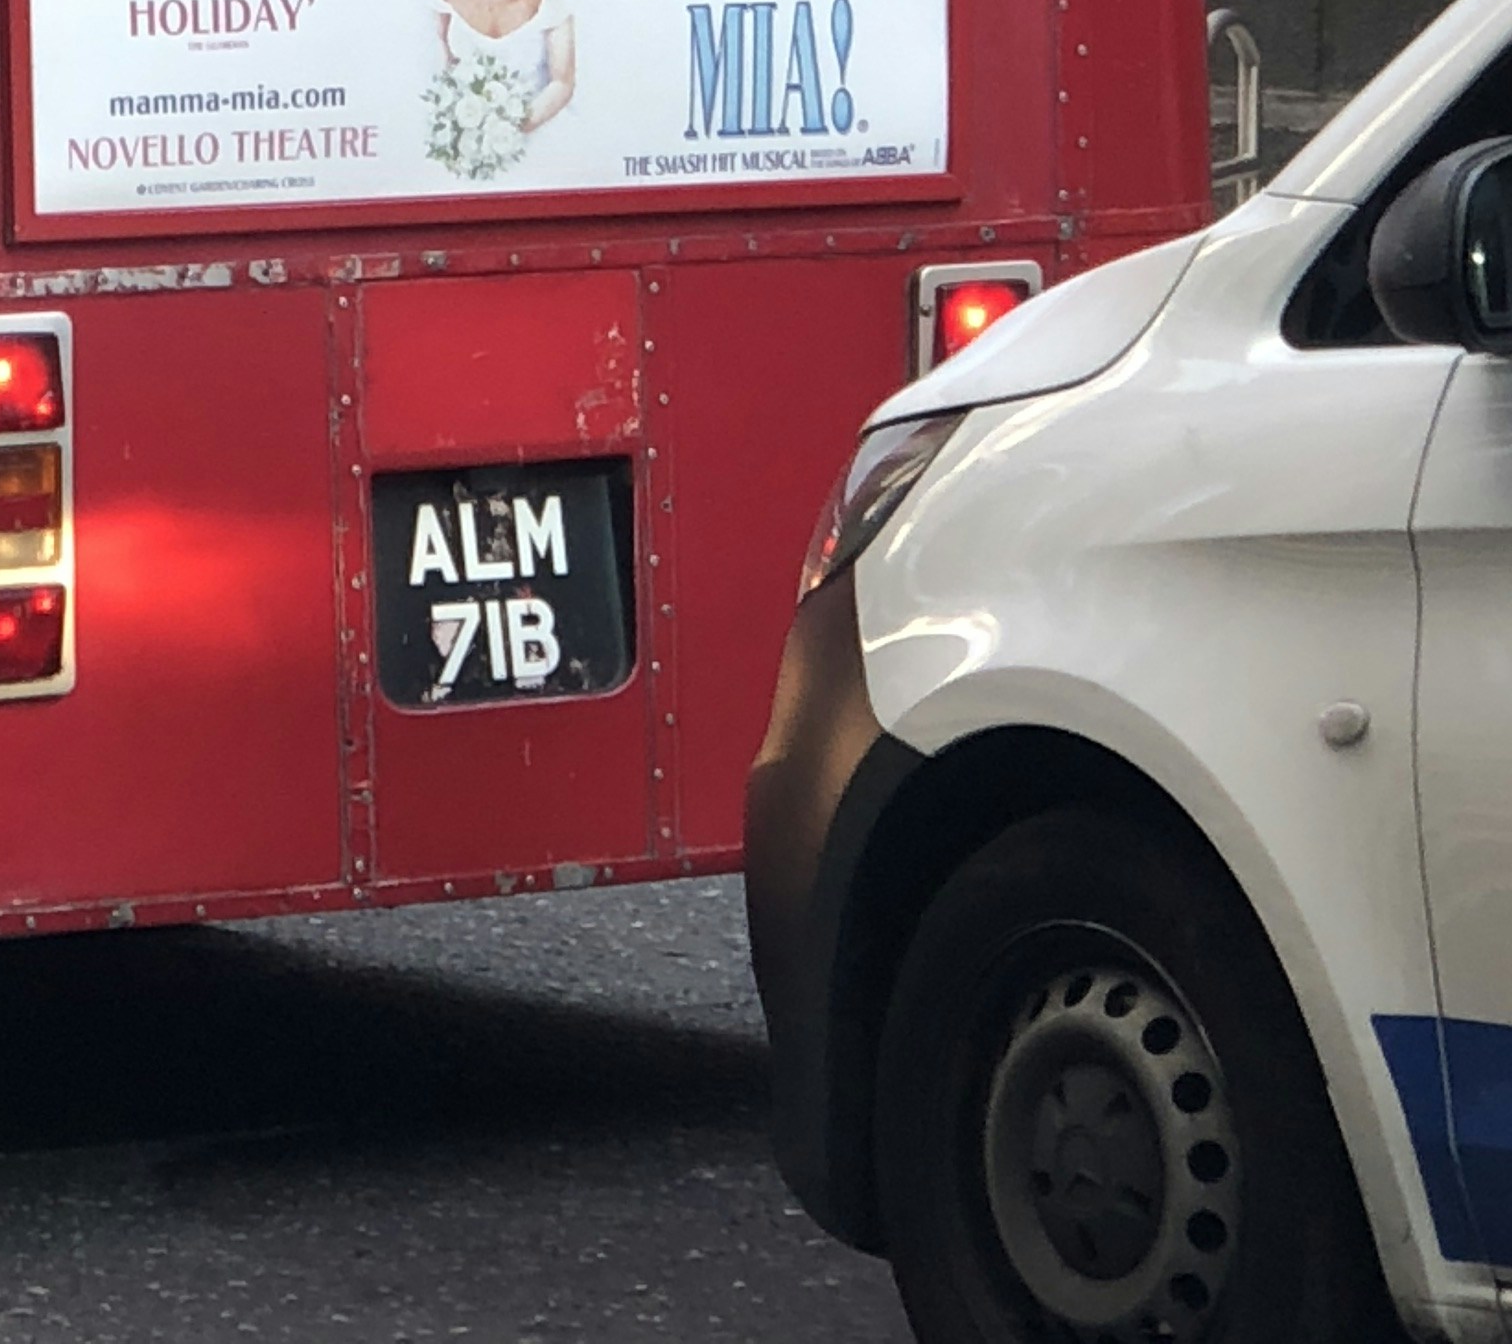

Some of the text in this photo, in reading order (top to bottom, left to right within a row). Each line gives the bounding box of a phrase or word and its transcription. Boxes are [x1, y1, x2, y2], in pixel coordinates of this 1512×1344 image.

[110, 85, 346, 117] mamma-mia.com
[67, 125, 379, 171] NOVELLO THEATRE
[623, 156, 651, 177] THE
[656, 154, 708, 175] SMASH
[712, 153, 736, 173] HIT
[742, 150, 809, 172] MUSICAL
[409, 495, 569, 586] ALM
[431, 598, 561, 685] 71B
